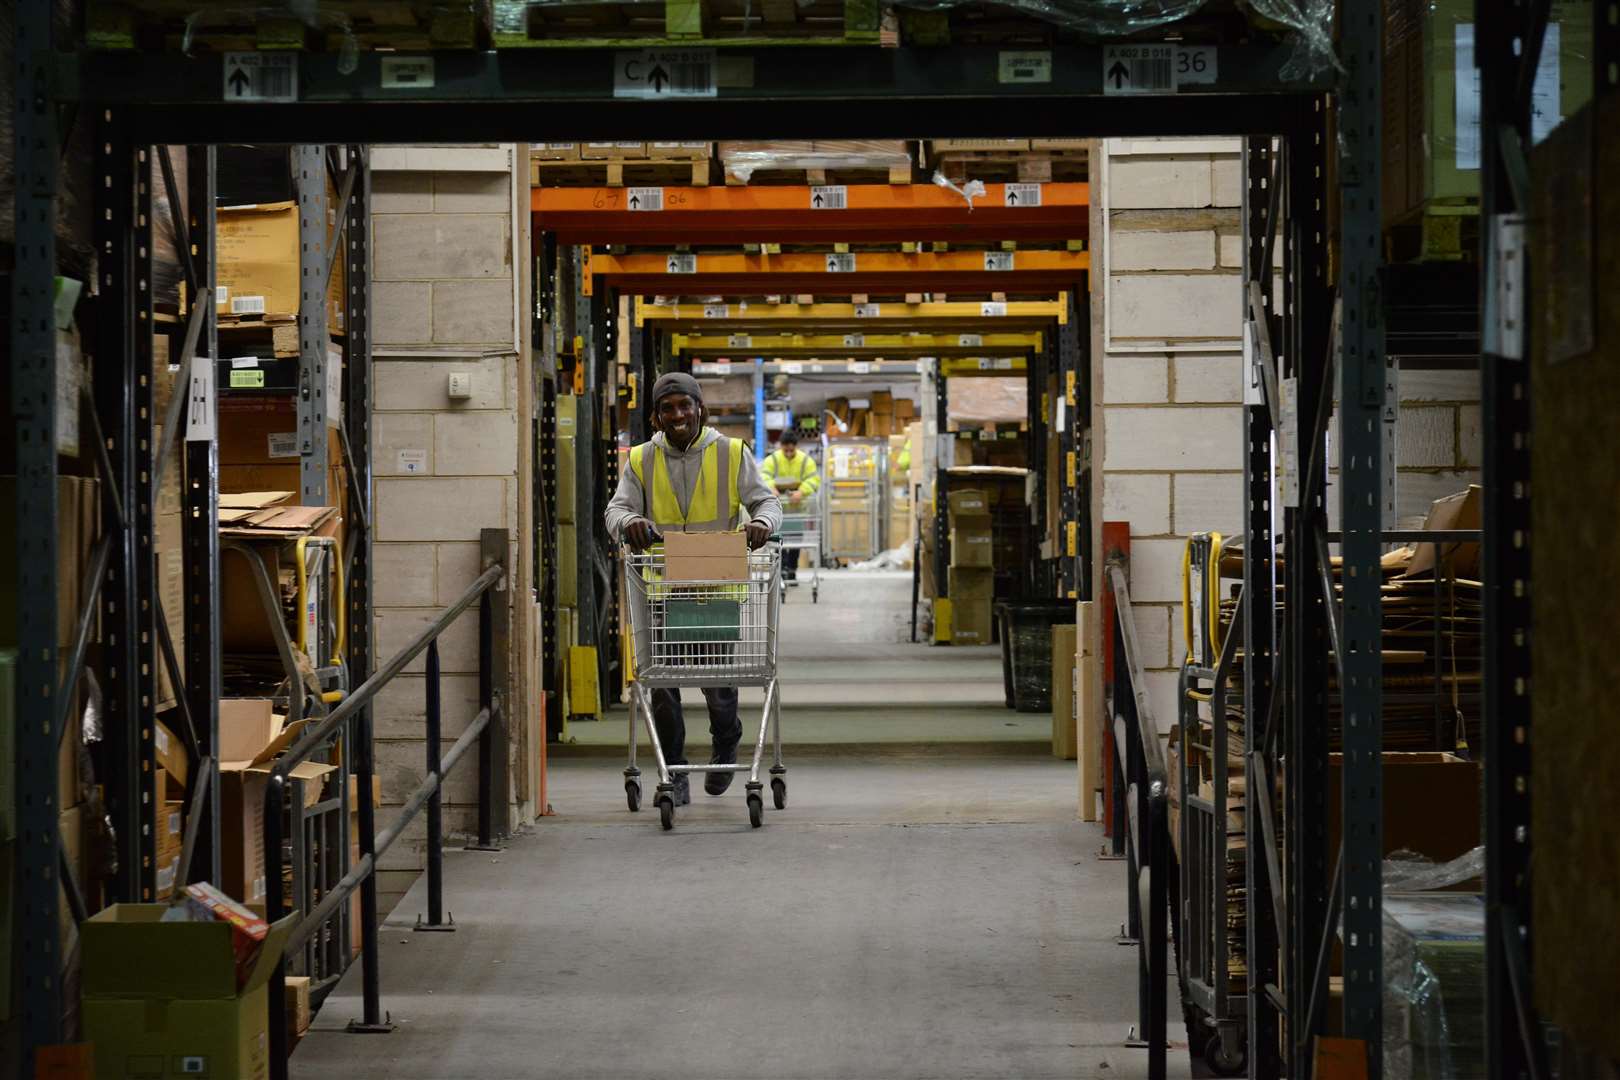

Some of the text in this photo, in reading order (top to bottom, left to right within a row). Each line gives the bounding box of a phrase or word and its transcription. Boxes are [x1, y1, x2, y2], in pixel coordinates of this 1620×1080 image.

[1109, 48, 1116, 57] A
[1120, 48, 1138, 57] 402
[1142, 48, 1149, 57] B
[647, 53, 656, 62] A
[1177, 51, 1206, 73] 36
